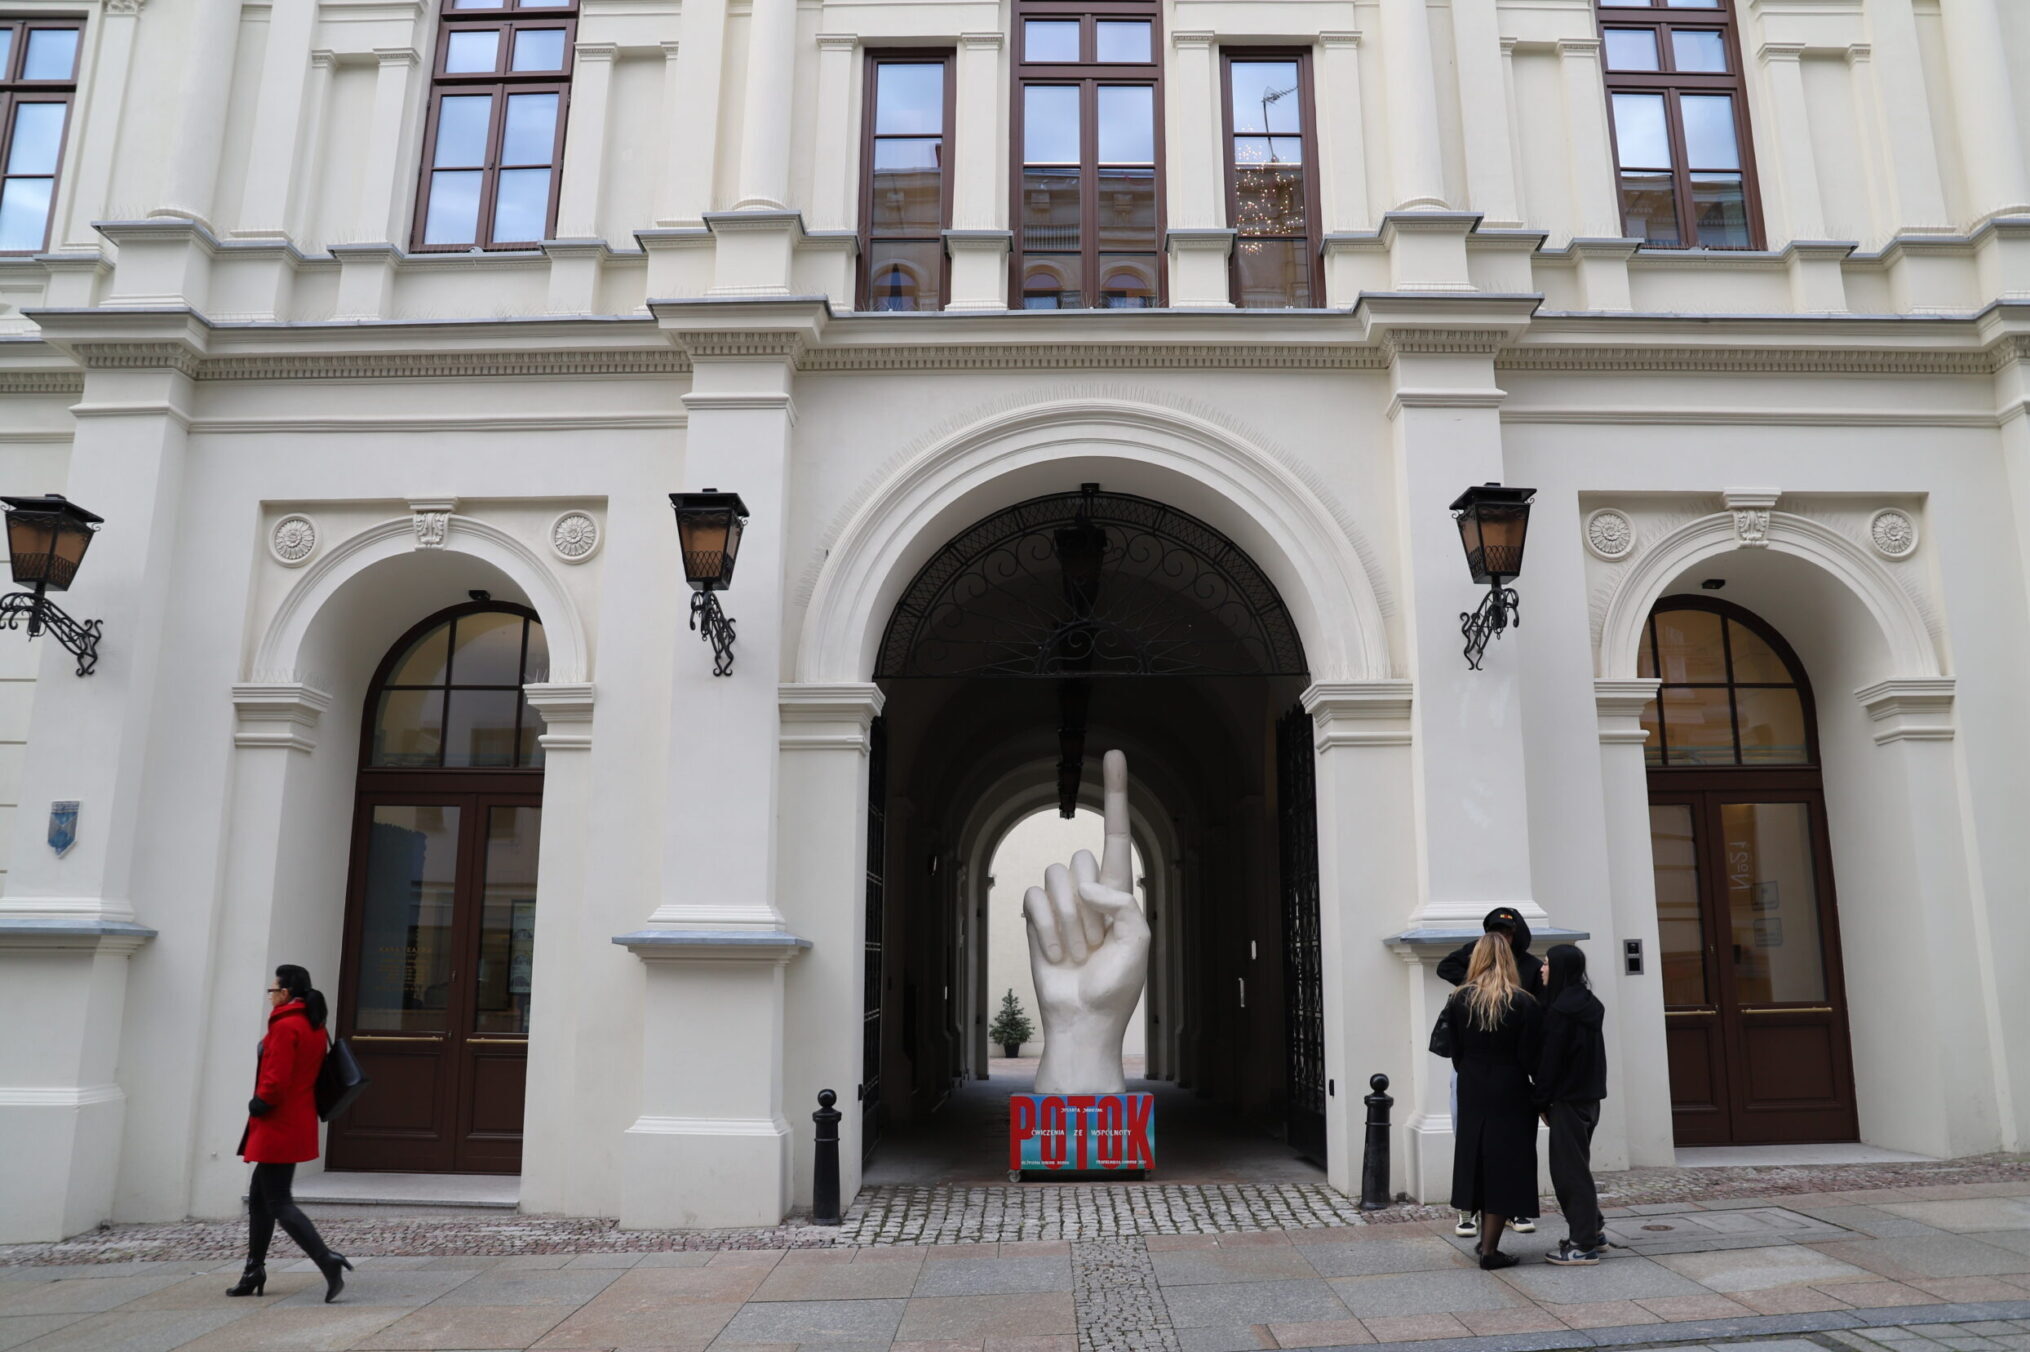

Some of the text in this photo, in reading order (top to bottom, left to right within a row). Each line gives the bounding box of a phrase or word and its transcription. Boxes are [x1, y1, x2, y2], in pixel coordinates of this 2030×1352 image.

[1010, 1095, 1155, 1170] POTOK
[1031, 1128, 1065, 1136] ĆWICZENIA
[1090, 1128, 1132, 1136] WSPÓLNOTY
